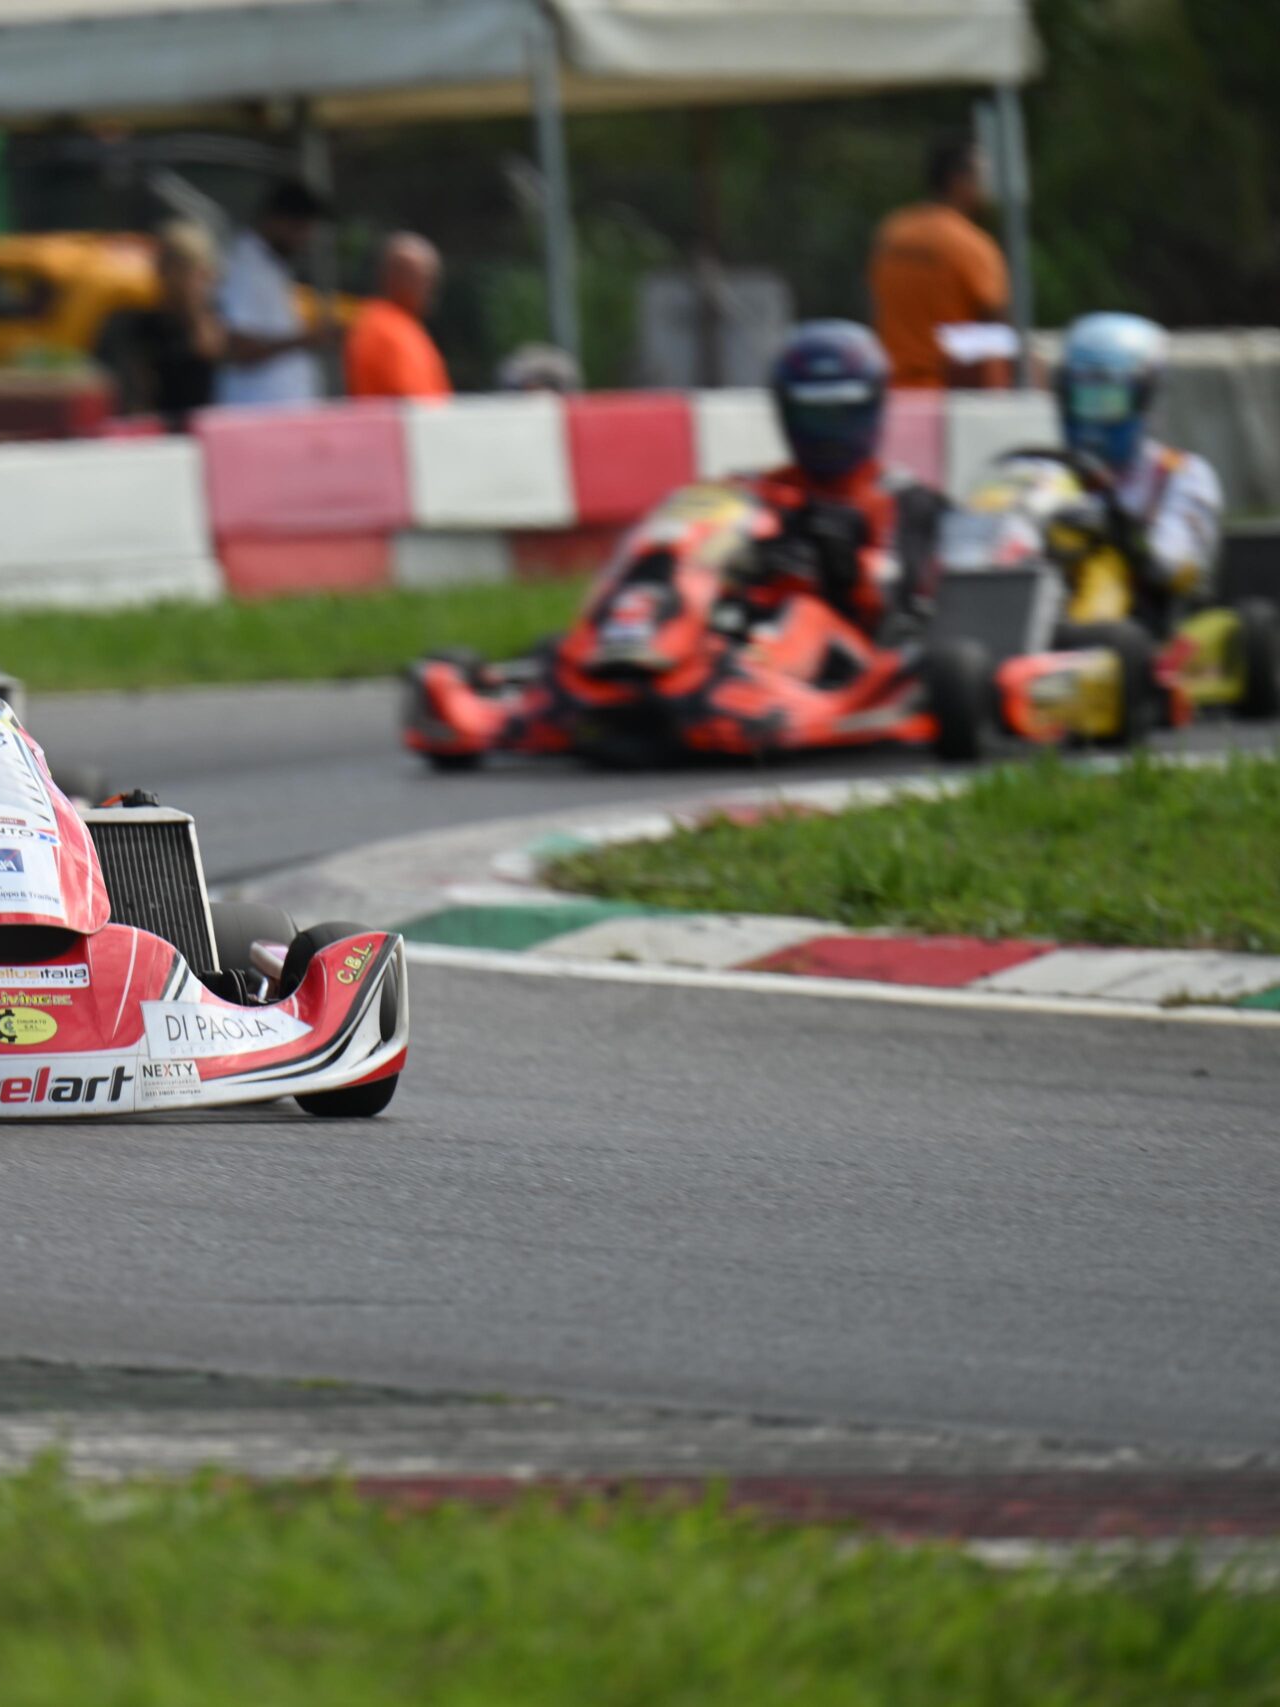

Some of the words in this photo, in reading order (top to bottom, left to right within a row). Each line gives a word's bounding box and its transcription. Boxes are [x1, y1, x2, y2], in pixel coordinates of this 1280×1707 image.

[165, 1014, 189, 1041] DI
[195, 1015, 277, 1041] PAOLA
[142, 1063, 193, 1078] NEXTY
